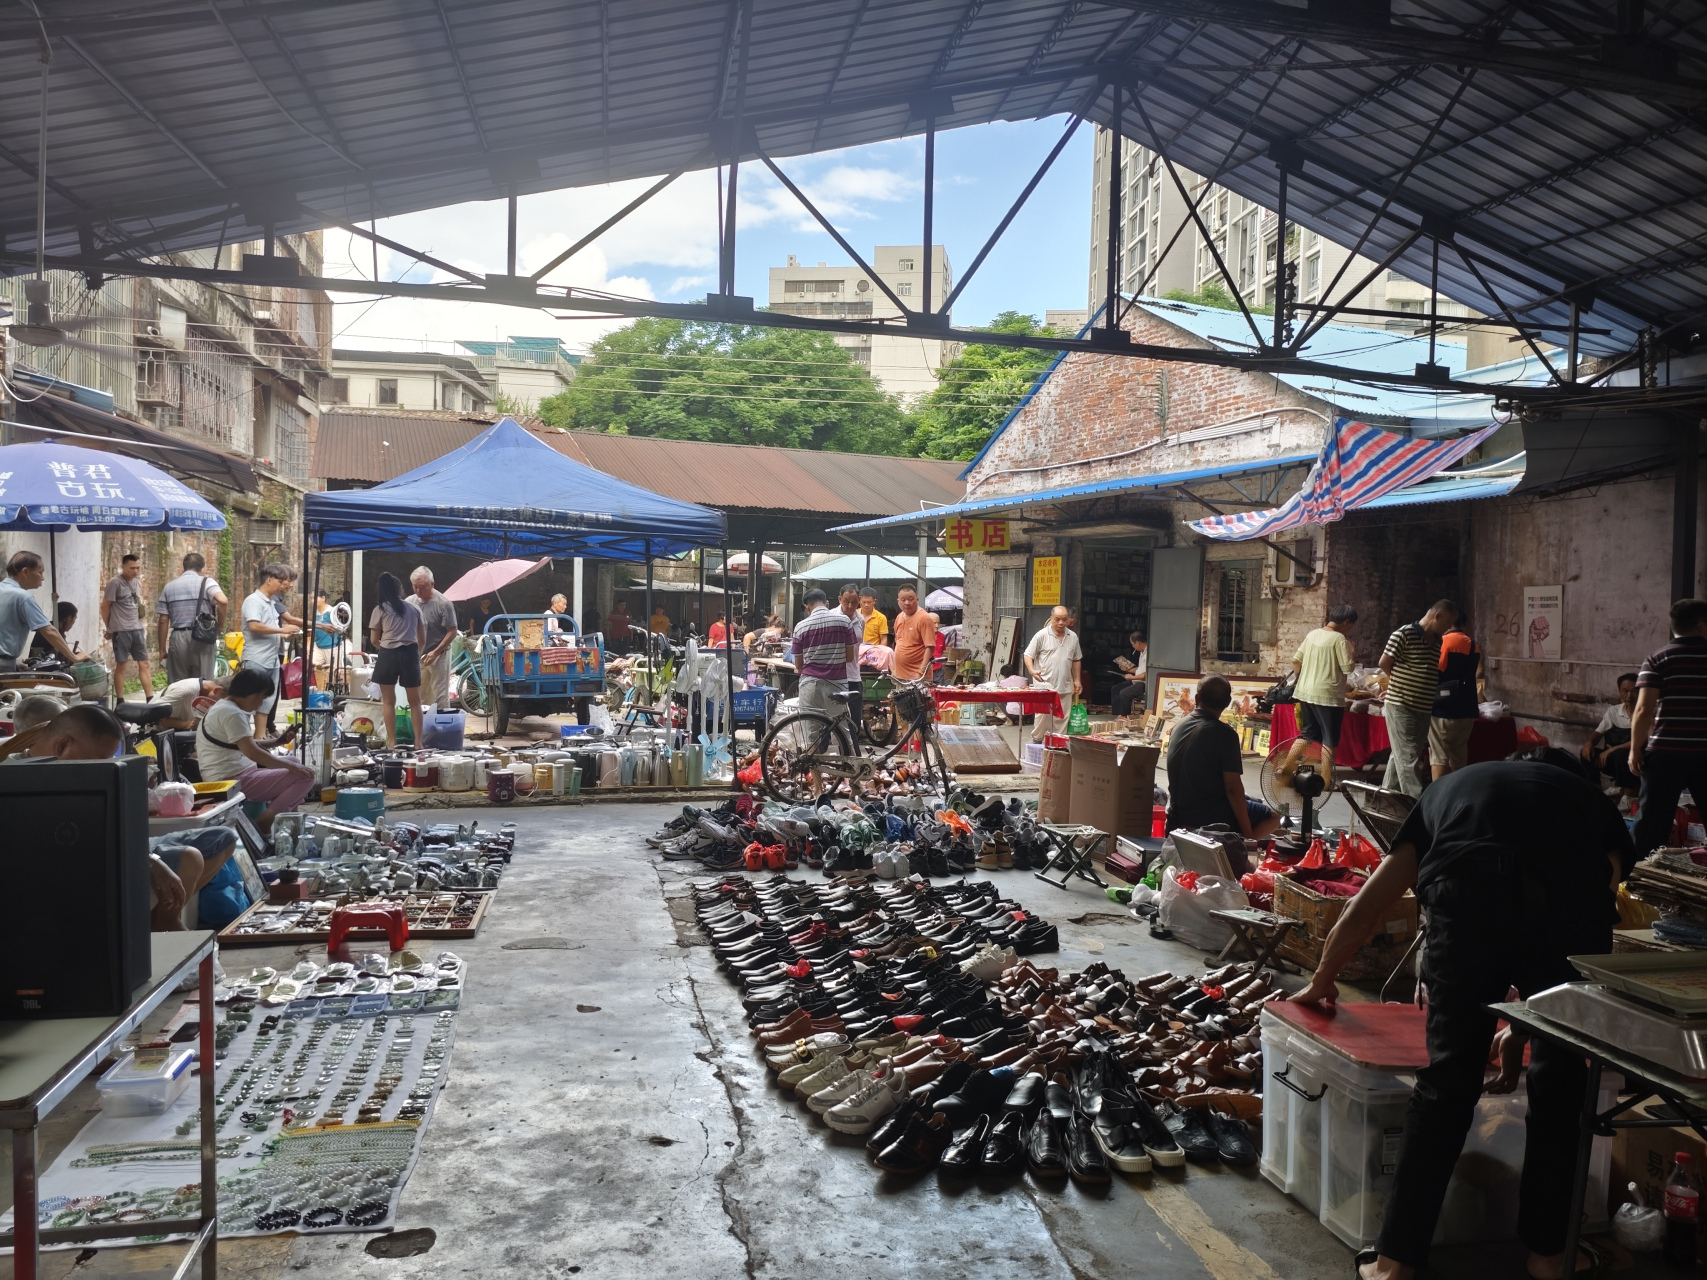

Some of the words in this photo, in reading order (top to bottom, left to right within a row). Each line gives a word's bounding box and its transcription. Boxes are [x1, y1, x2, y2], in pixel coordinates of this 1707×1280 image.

[46, 460, 112, 480] 普君
[55, 481, 126, 499] 古玩
[949, 520, 1006, 549] 书店
[1494, 611, 1520, 637] 26
[23, 1000, 41, 1009] JBL
